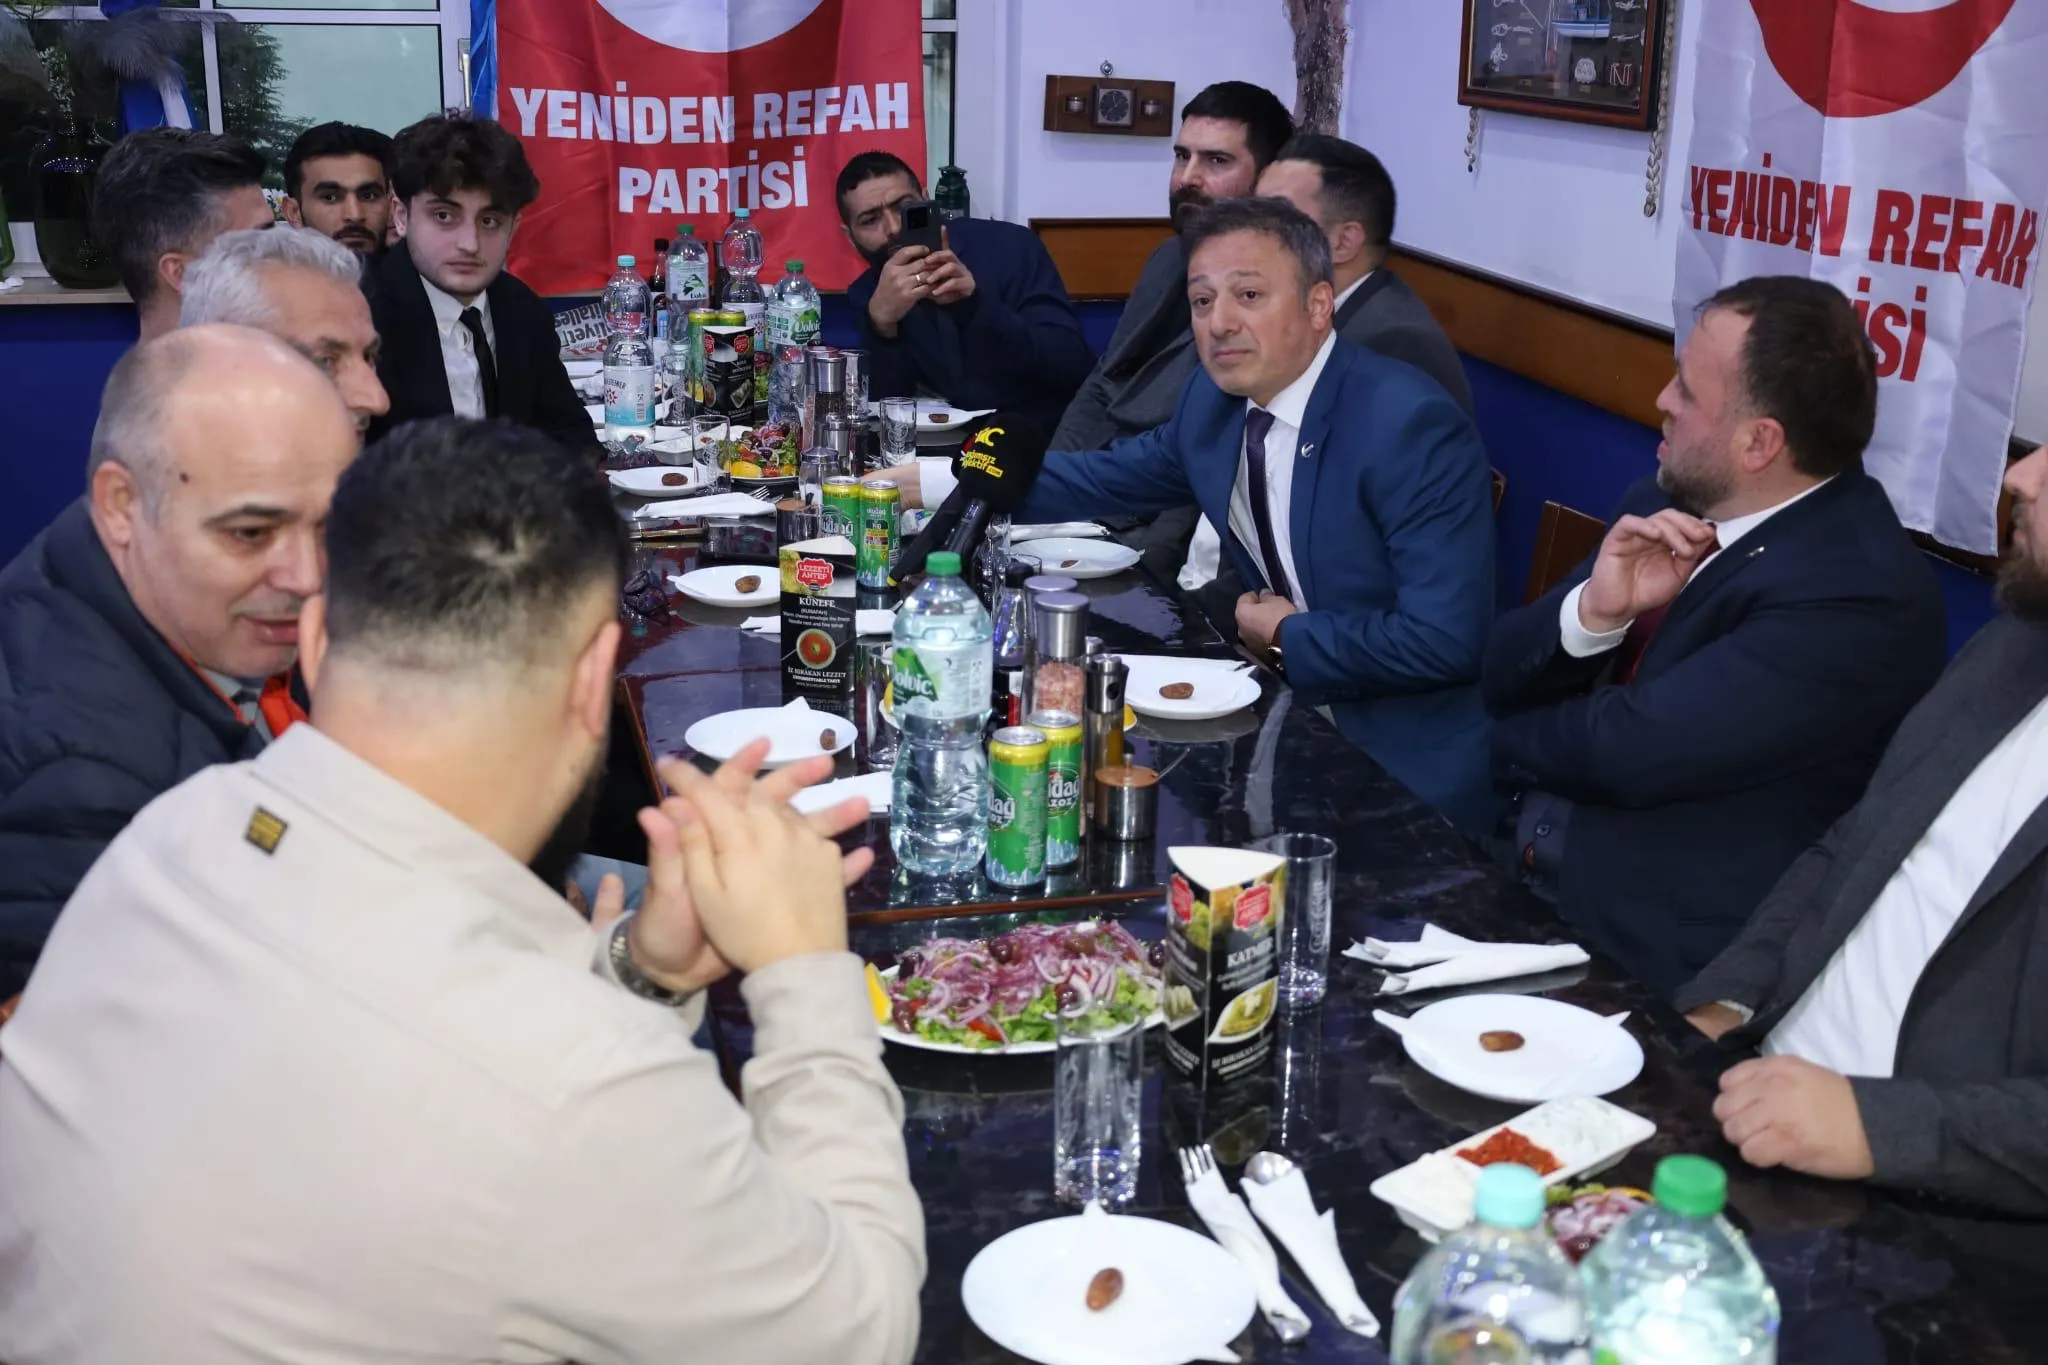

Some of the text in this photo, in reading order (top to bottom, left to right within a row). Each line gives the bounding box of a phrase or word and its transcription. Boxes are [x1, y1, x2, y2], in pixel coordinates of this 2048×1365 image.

[509, 80, 910, 145] YENİDEN REFAH
[618, 144, 809, 214] PARTİSİ
[1690, 152, 2038, 290] YENİDEN REFAH
[799, 595, 836, 609] KÜNEFE
[893, 664, 934, 697] olvic
[1048, 775, 1080, 798] dağ
